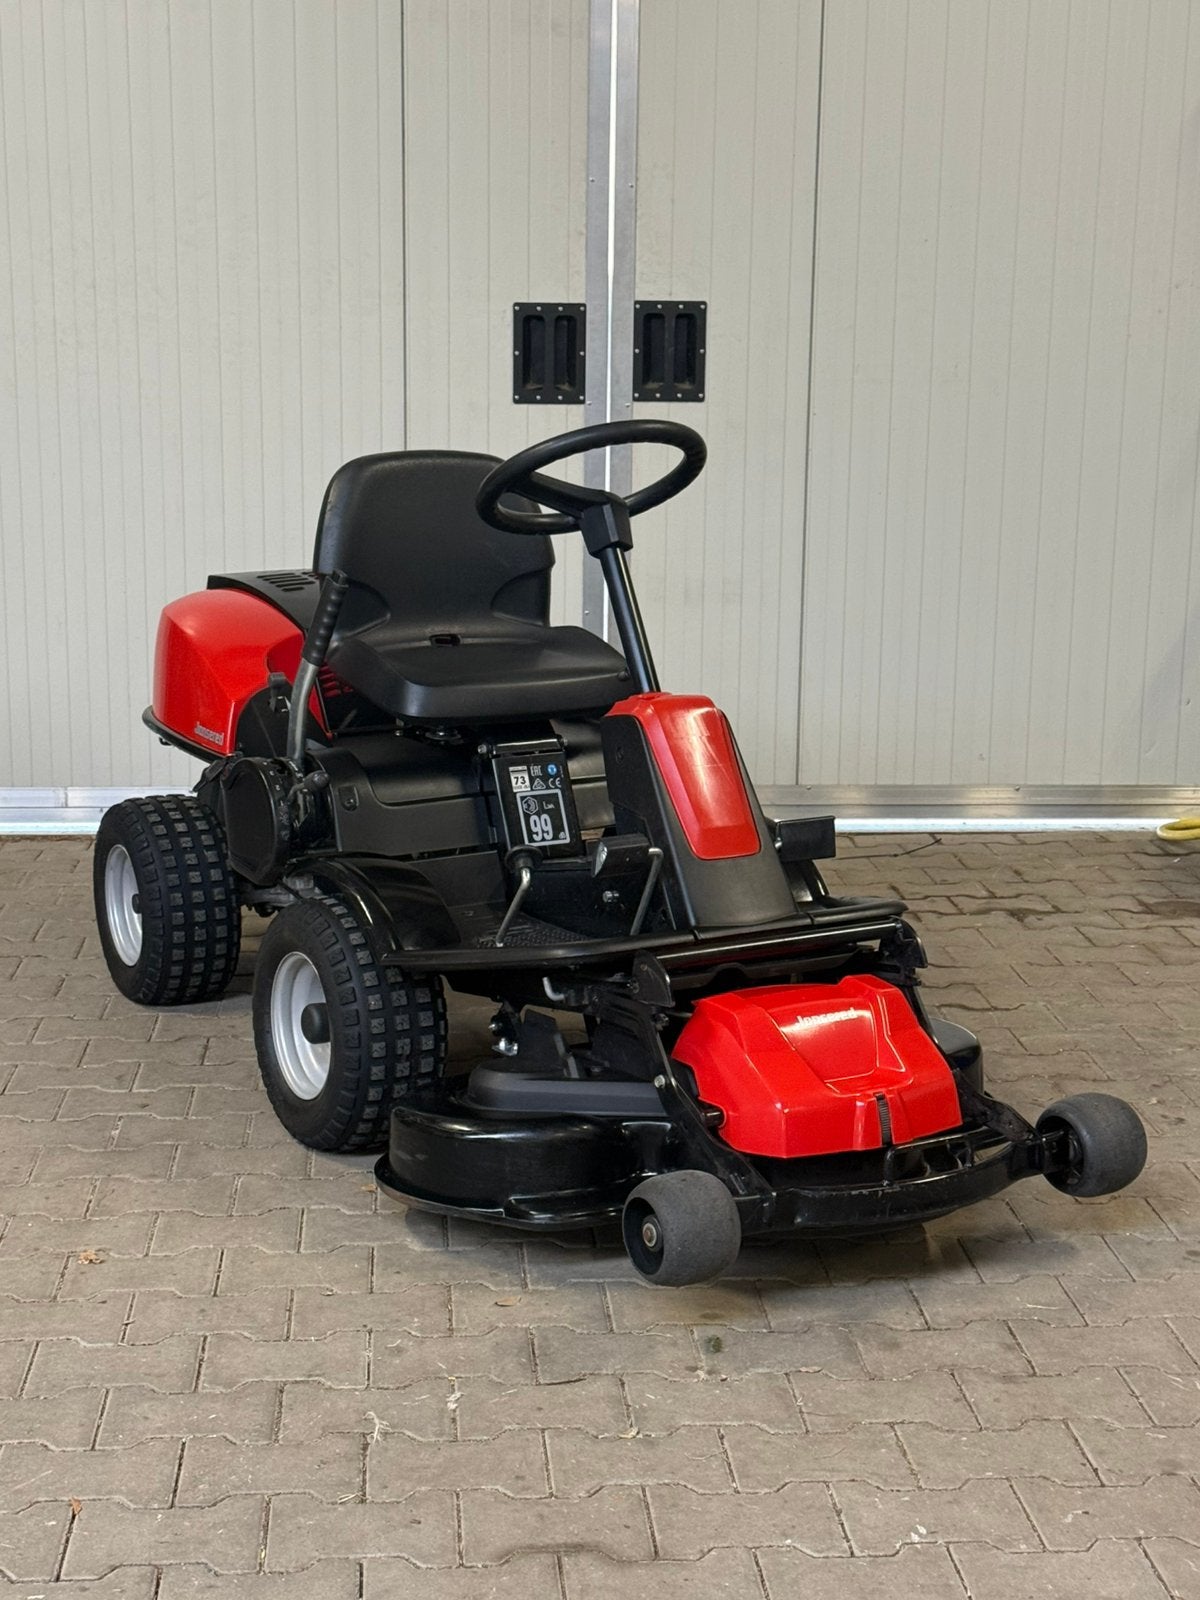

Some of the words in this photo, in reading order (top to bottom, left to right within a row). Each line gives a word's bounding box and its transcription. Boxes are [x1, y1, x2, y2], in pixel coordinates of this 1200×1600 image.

[513, 775, 526, 785] 73
[548, 777, 562, 788] CE
[529, 814, 553, 841] 99
[795, 1007, 857, 1029] Jonsered
